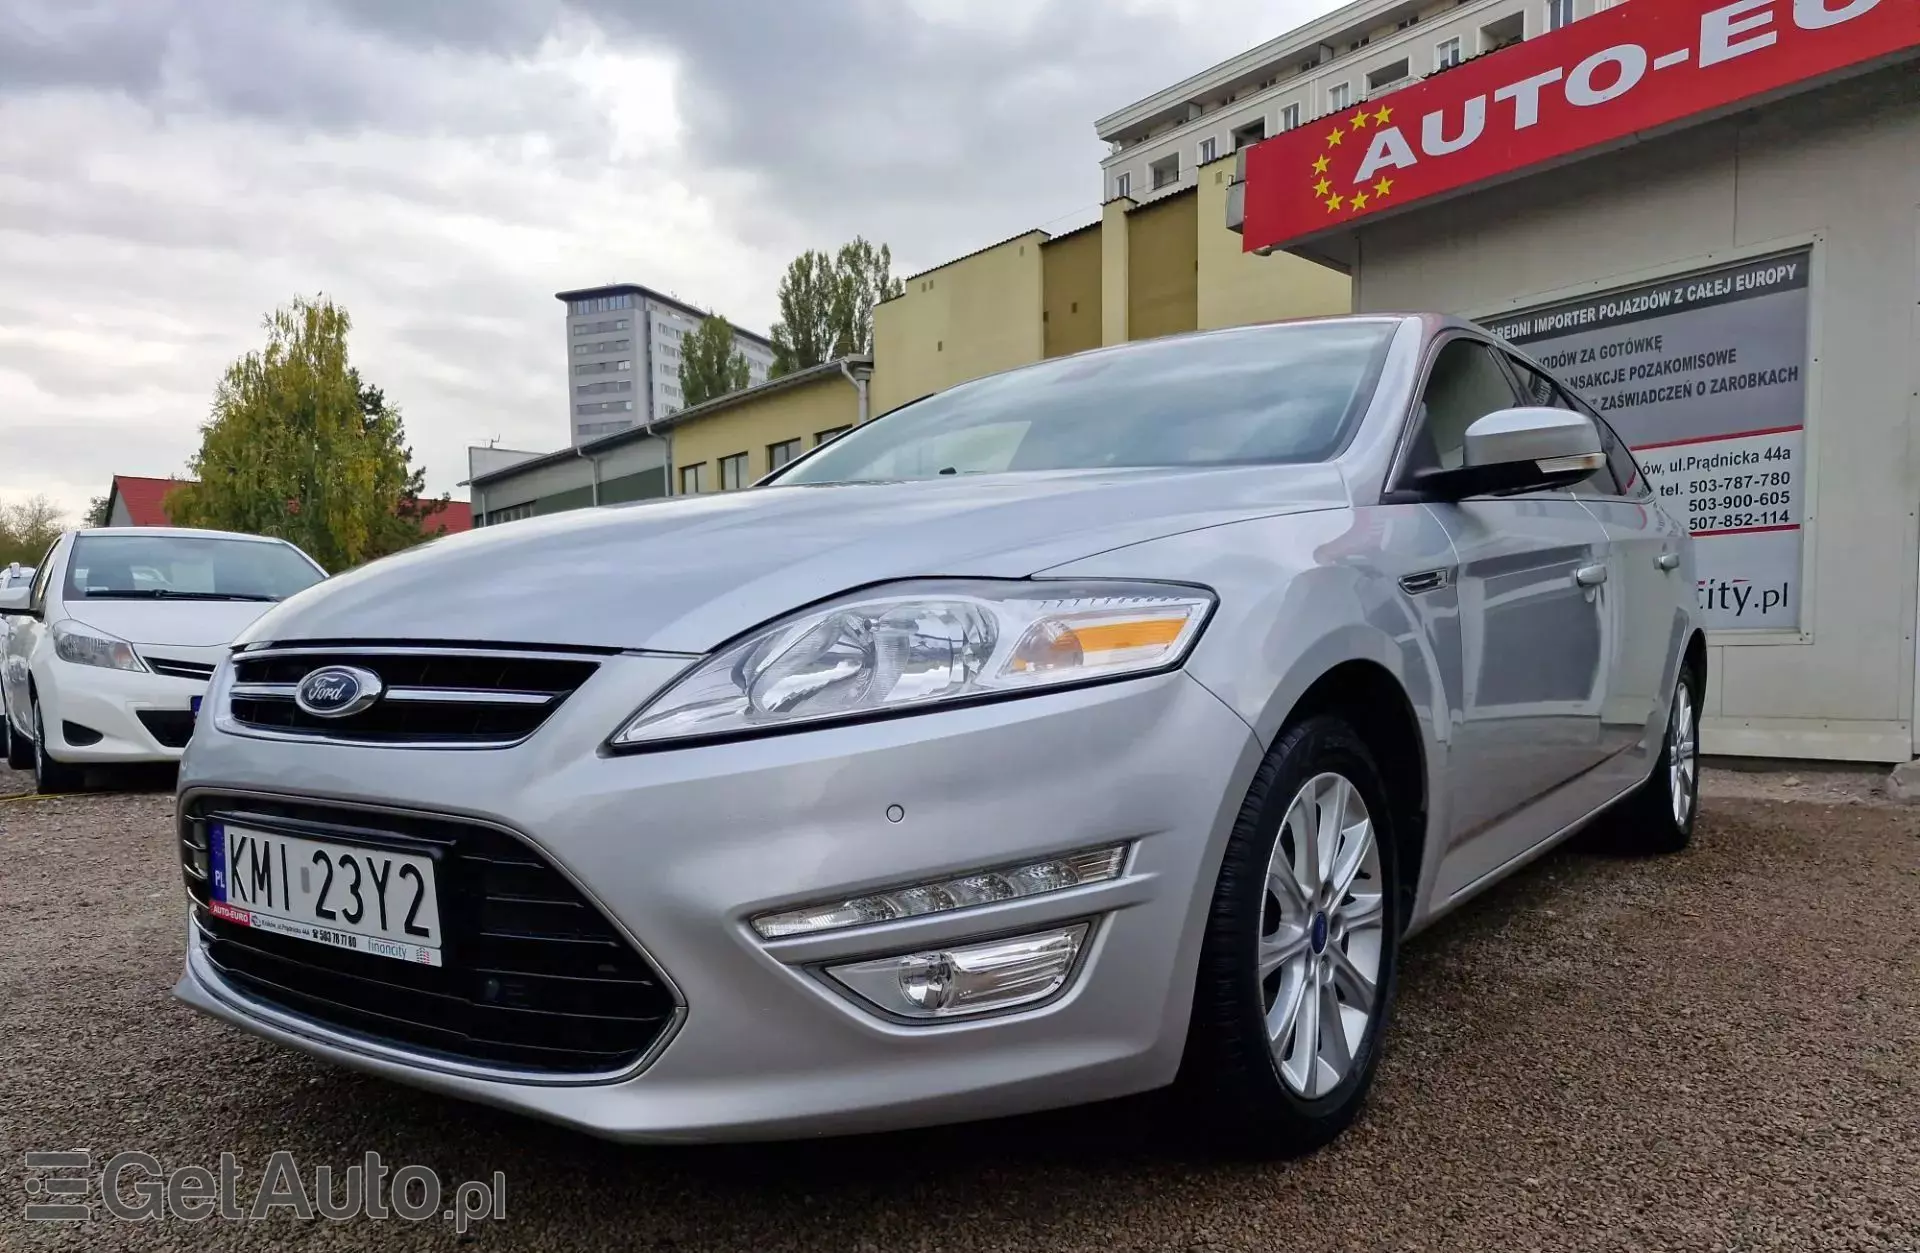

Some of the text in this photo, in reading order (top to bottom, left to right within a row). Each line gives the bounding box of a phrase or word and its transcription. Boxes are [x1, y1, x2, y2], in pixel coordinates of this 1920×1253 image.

[1534, 307, 1596, 334] IMPORTER
[1599, 290, 1671, 320] POJAZDÓW
[1673, 288, 1684, 304] Z
[1687, 277, 1731, 302] CAŁEJ
[1736, 263, 1797, 292] EUROPY
[1539, 335, 1663, 369] ODÓW ZA GOTÓWKĘ
[1565, 348, 1737, 390] NSAKCJE POZAKOMISOWE
[1600, 365, 1798, 411] ZAŚWIADCZEŃ O ZAROBKACH
[1669, 450, 1760, 473] ul.Prądnicka
[1763, 445, 1791, 462] 44a
[1660, 482, 1683, 497] tel.
[1689, 471, 1790, 494] 503-787-780
[1688, 490, 1790, 513] 503-900-605
[1688, 509, 1790, 531] 507-852-114
[308, 676, 346, 701] Ford
[214, 869, 226, 889] PL
[230, 833, 430, 939] KMI 23Y2
[213, 904, 249, 923] AUTO-EURO
